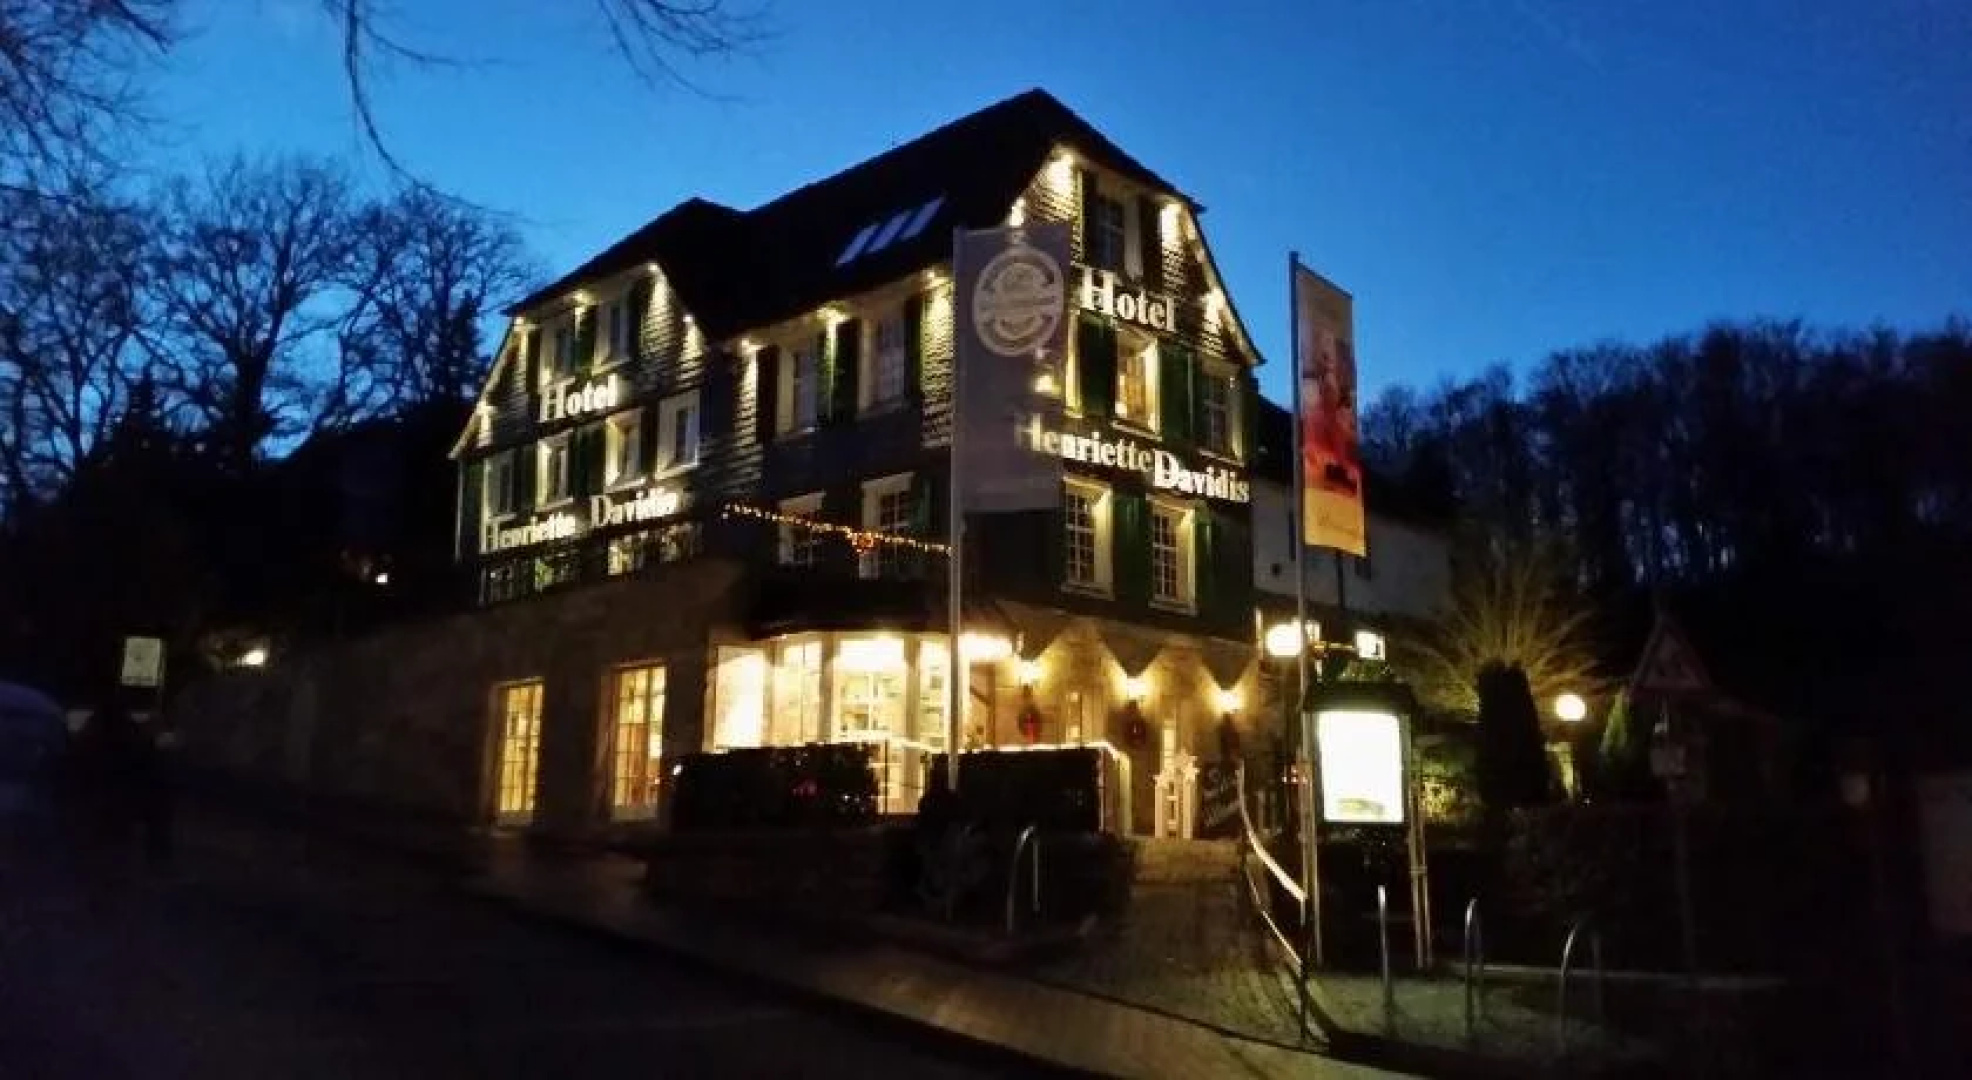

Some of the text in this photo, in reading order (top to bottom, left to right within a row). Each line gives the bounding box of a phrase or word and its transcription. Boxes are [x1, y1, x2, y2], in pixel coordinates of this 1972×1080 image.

[1081, 268, 1176, 332] Hotel
[539, 373, 618, 423] Hotel
[1015, 413, 1250, 502] Henriette Davidis
